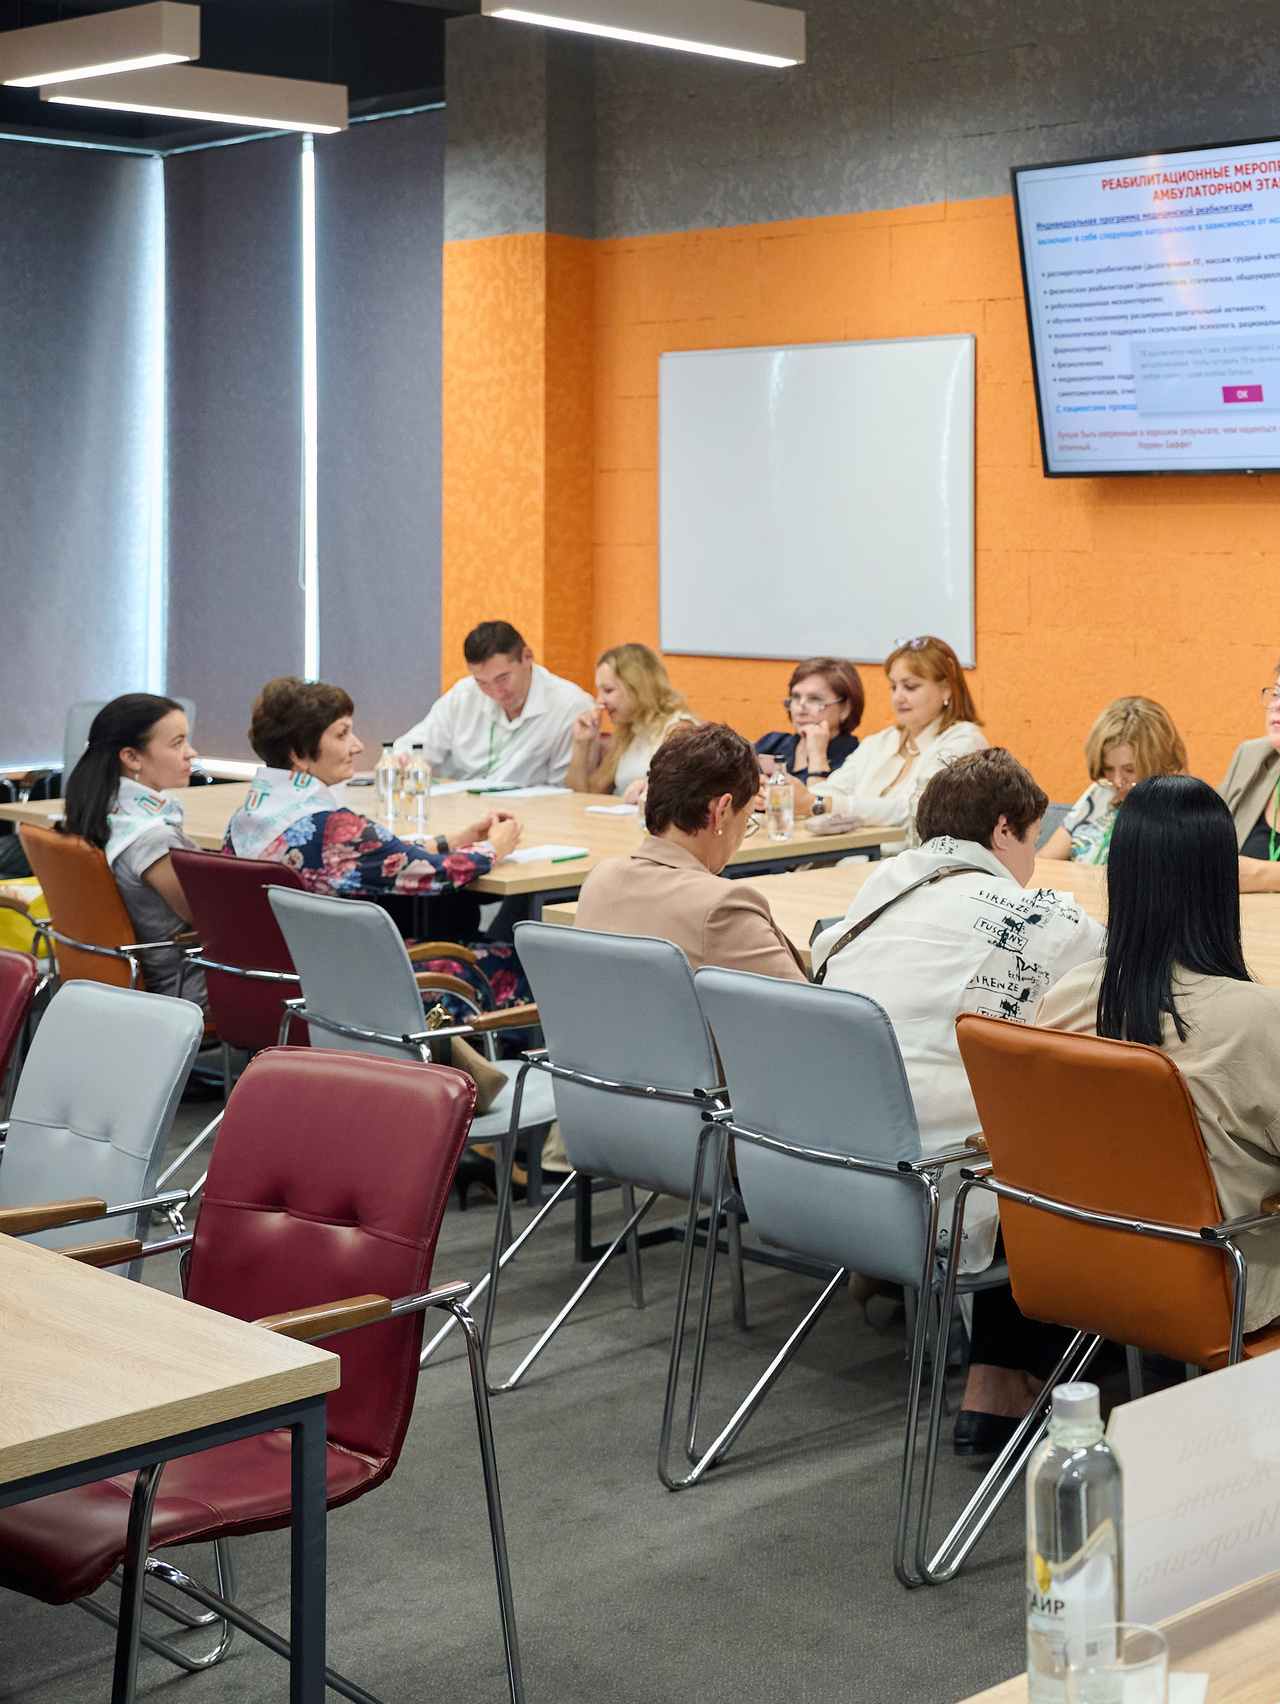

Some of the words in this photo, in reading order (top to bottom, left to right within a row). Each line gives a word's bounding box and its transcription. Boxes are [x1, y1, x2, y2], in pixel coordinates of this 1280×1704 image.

[1102, 166, 1230, 191] РЕАБИЛИТАЦИОННЫЕ
[1153, 180, 1252, 201] АМБУЛАТОРНОМ
[979, 890, 1030, 914] FIRENZE
[980, 920, 1022, 947] TUSCNY.
